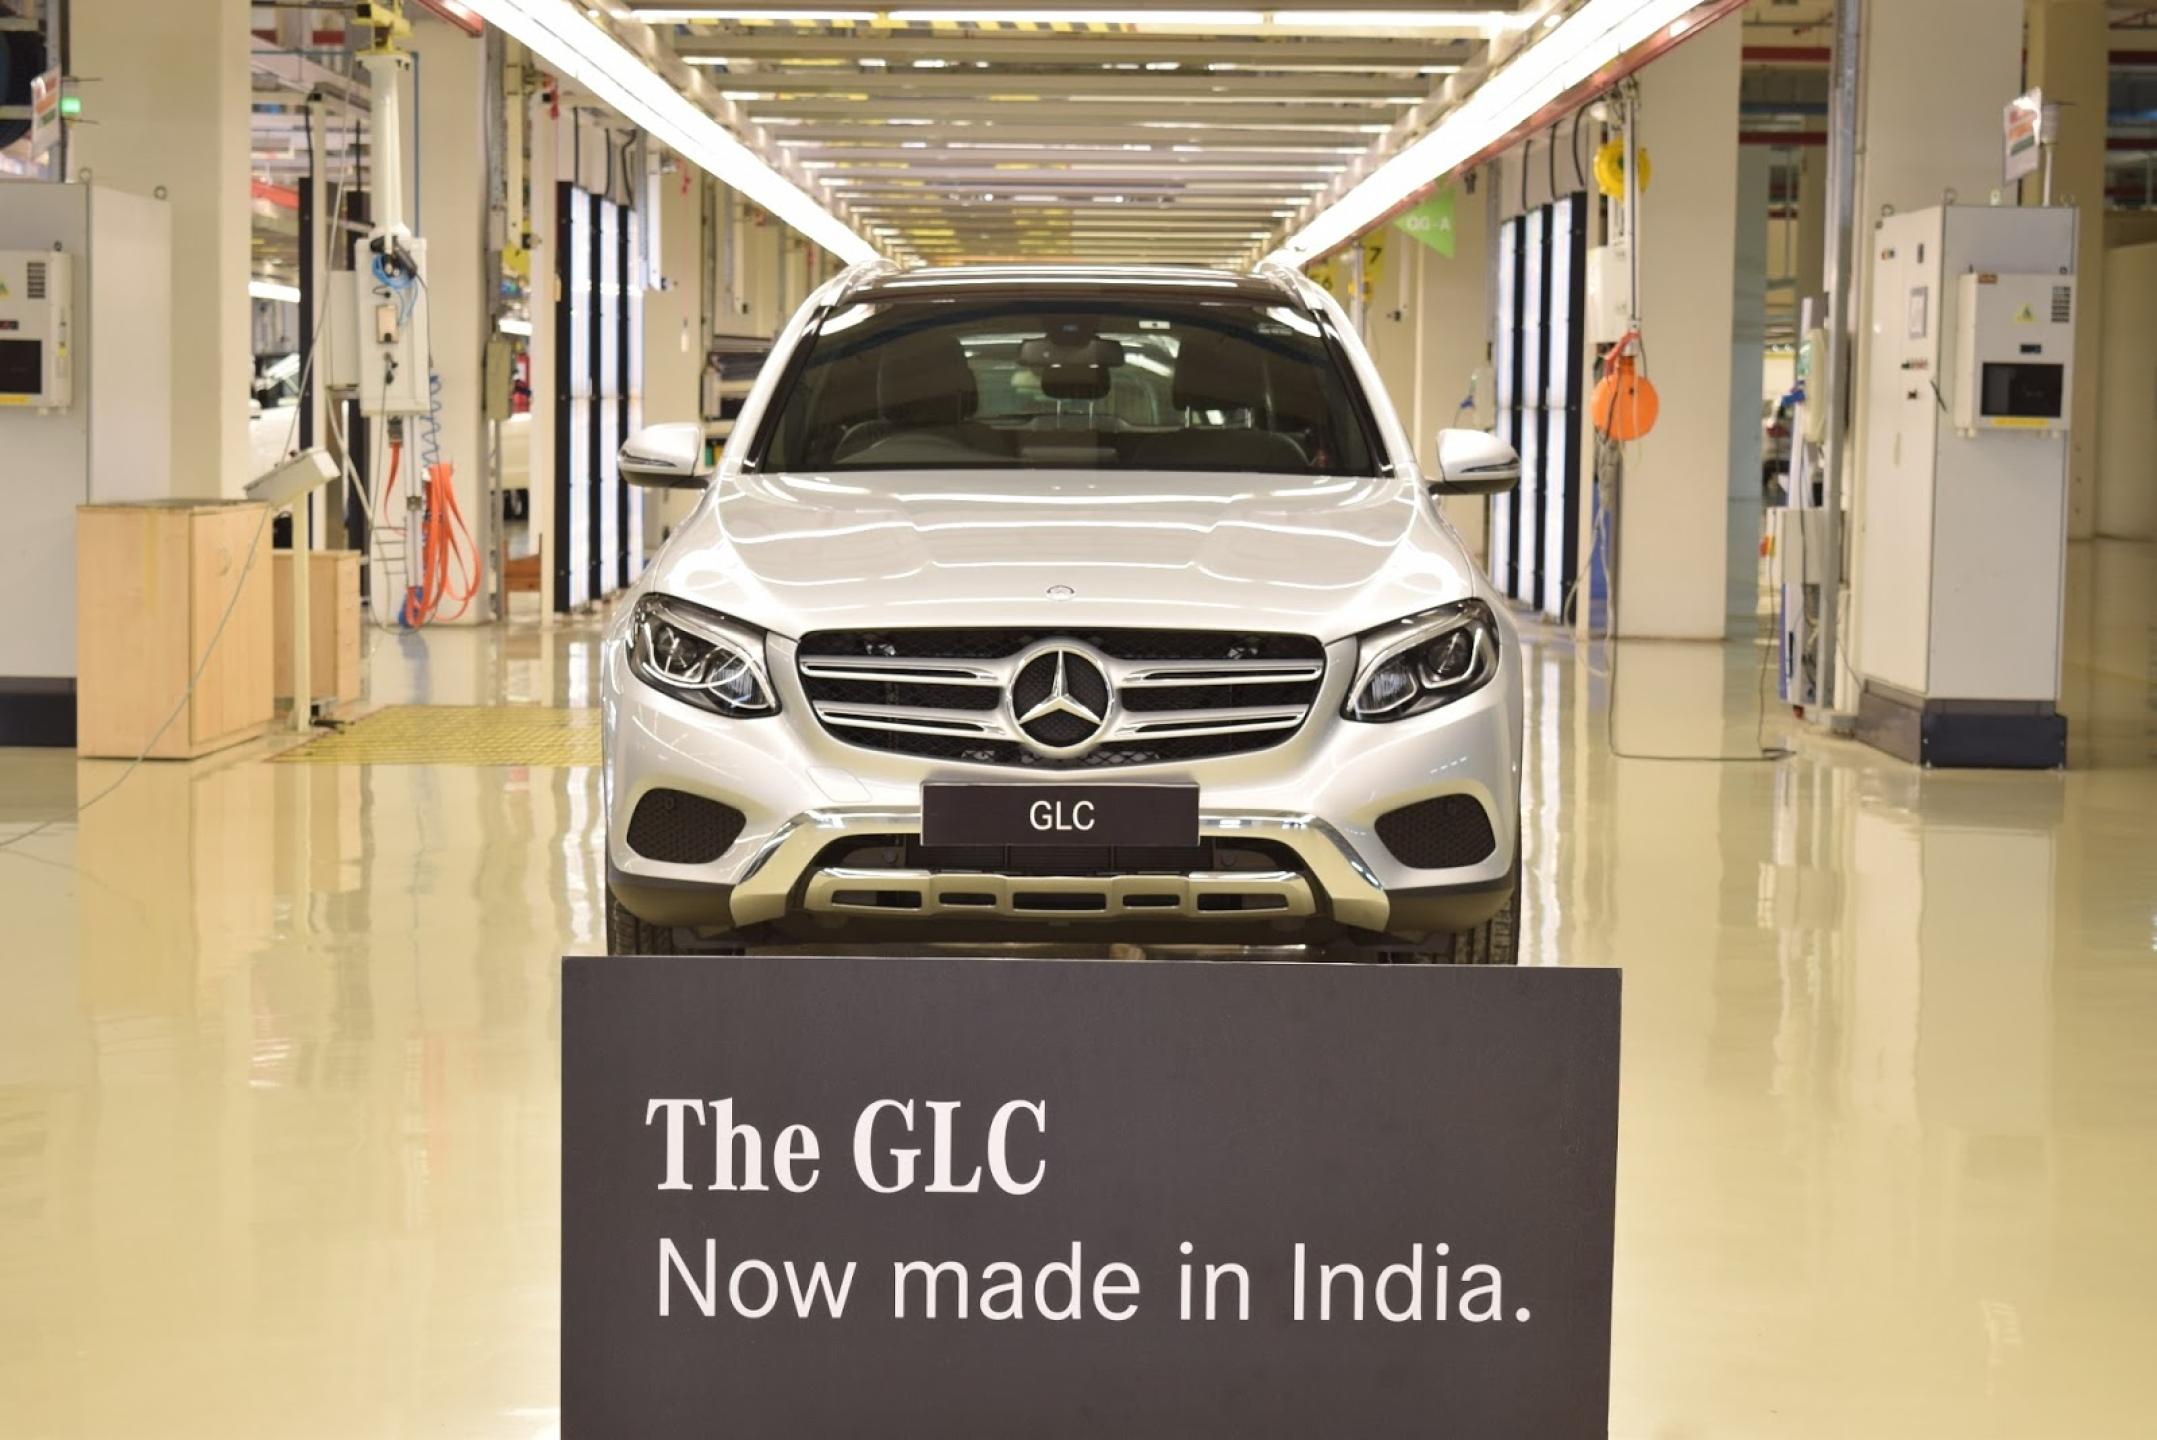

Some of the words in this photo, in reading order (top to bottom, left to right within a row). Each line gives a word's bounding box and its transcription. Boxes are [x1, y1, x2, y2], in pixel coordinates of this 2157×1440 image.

[1369, 247, 1383, 265] 7
[1029, 800, 1096, 831] GLC
[645, 1097, 820, 1193] The
[853, 1098, 1047, 1196] GLC
[658, 1237, 857, 1319] Now
[893, 1241, 1140, 1321] made
[1179, 1241, 1250, 1321] in
[1292, 1242, 1531, 1323] India.
